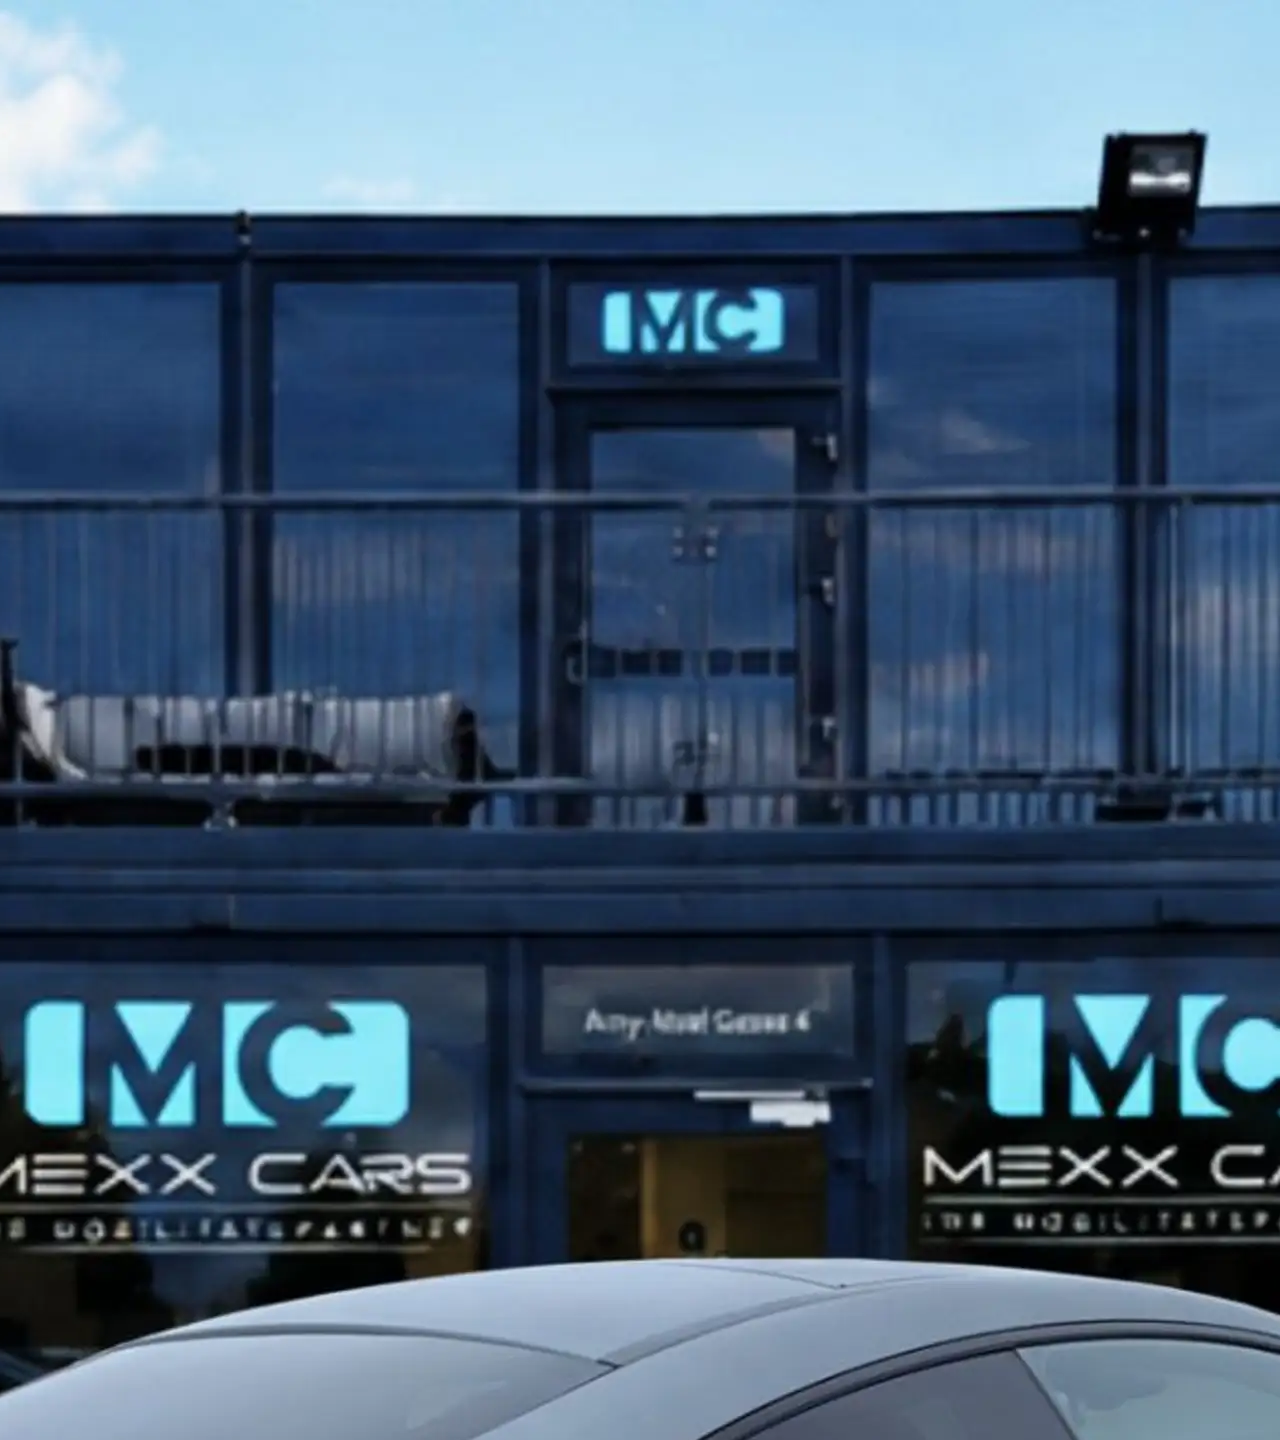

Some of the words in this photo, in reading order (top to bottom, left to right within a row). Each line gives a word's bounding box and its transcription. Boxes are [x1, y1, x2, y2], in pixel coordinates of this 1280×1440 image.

[625, 290, 762, 352] MC
[70, 1001, 370, 1126] MC
[248, 1151, 472, 1195] CARS
[923, 1145, 1178, 1188] MEXX
